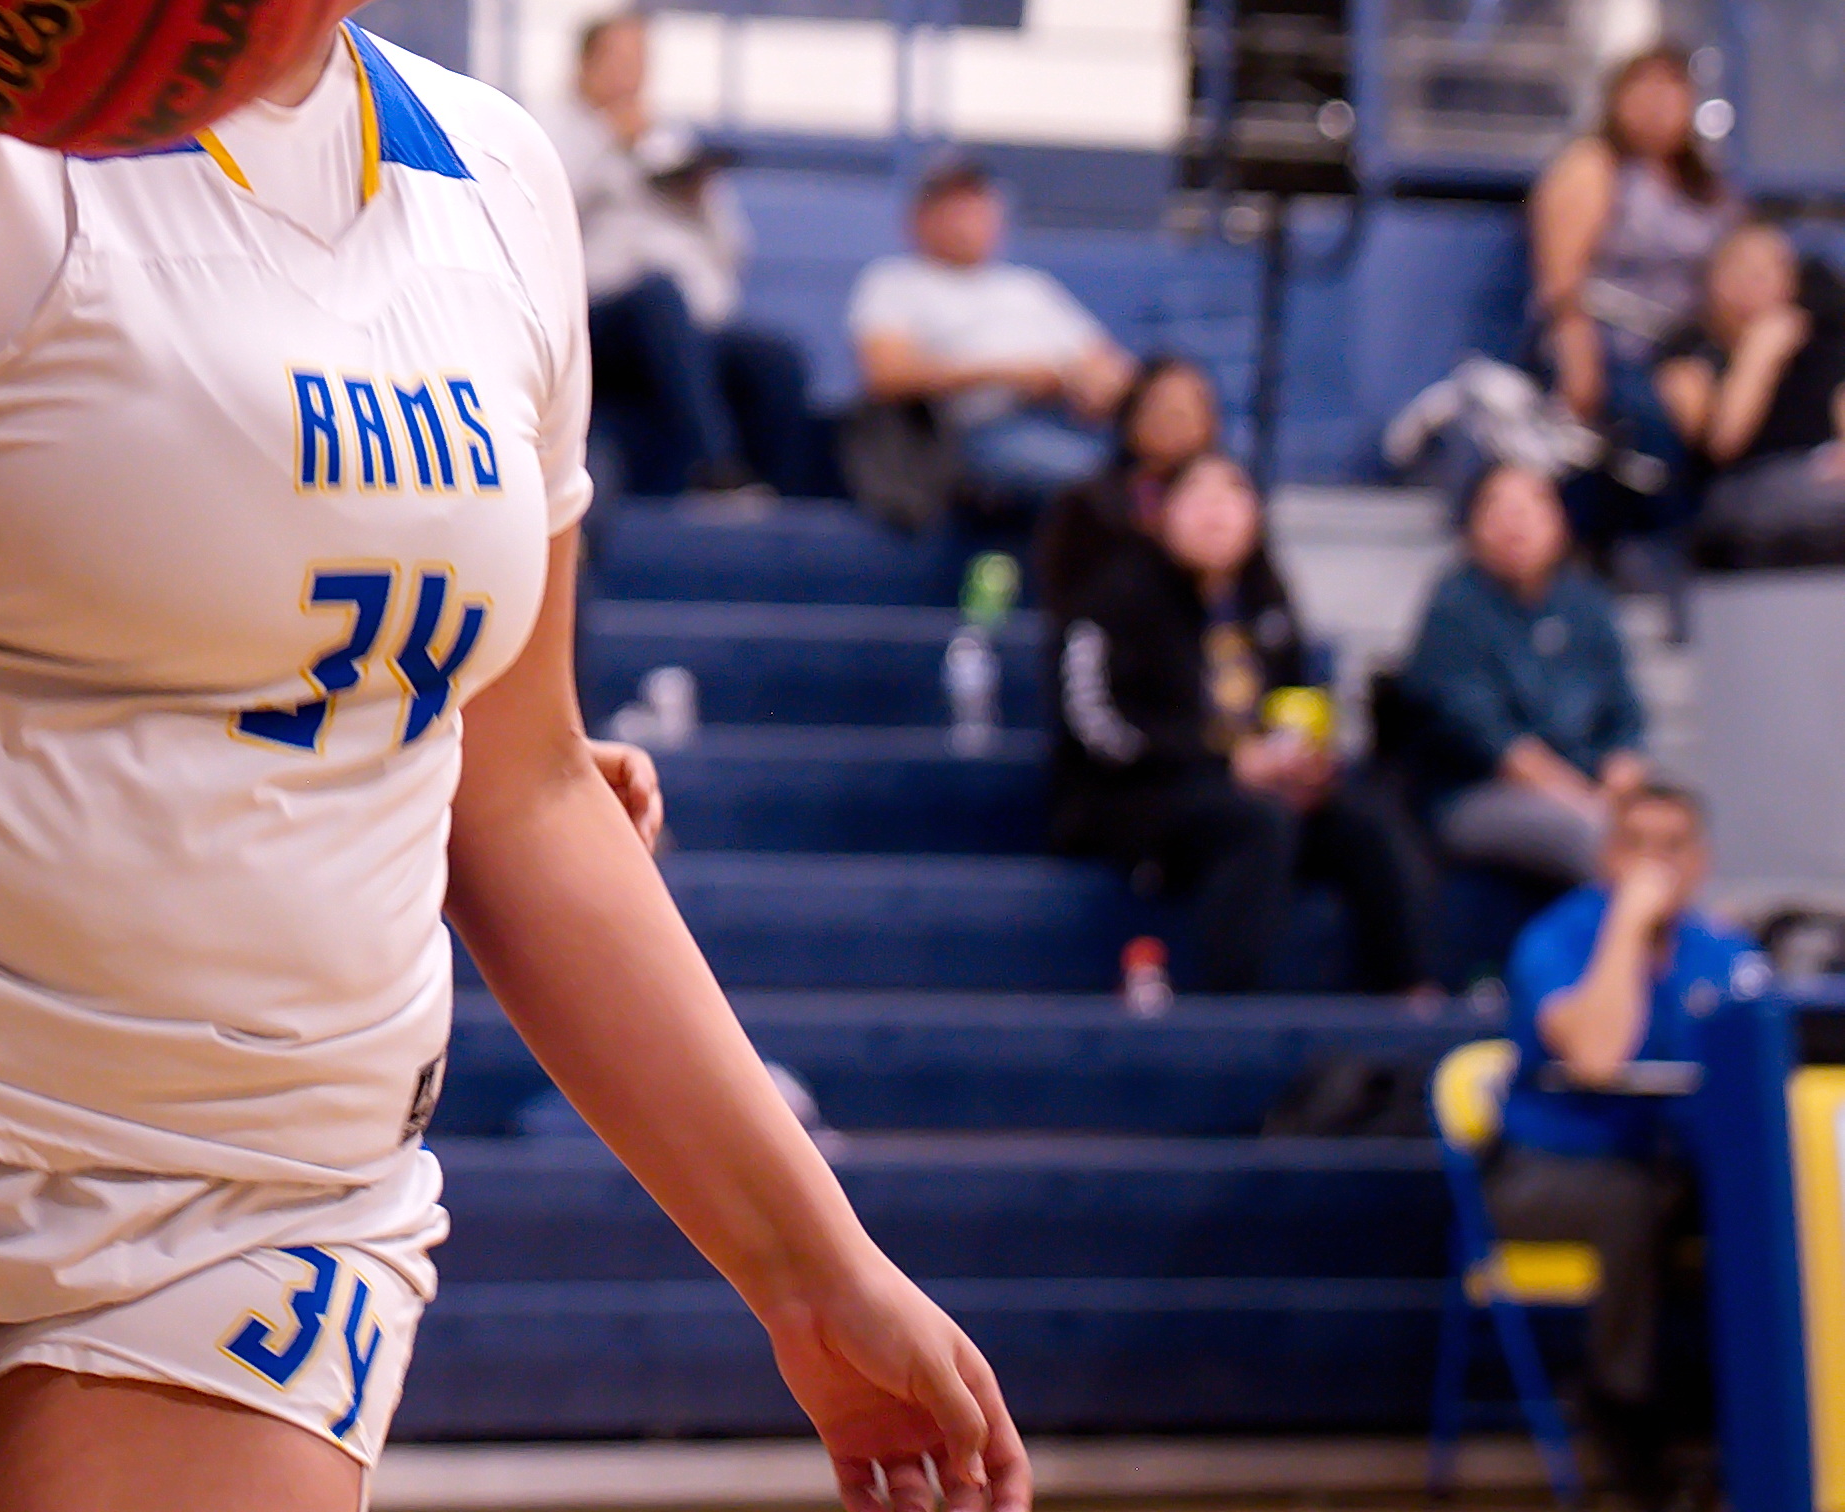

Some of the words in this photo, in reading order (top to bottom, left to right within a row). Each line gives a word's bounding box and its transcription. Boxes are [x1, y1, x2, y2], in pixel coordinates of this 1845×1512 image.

[287, 364, 503, 498] RAMS
[229, 558, 495, 754] 34
[217, 1243, 387, 1446] 34
